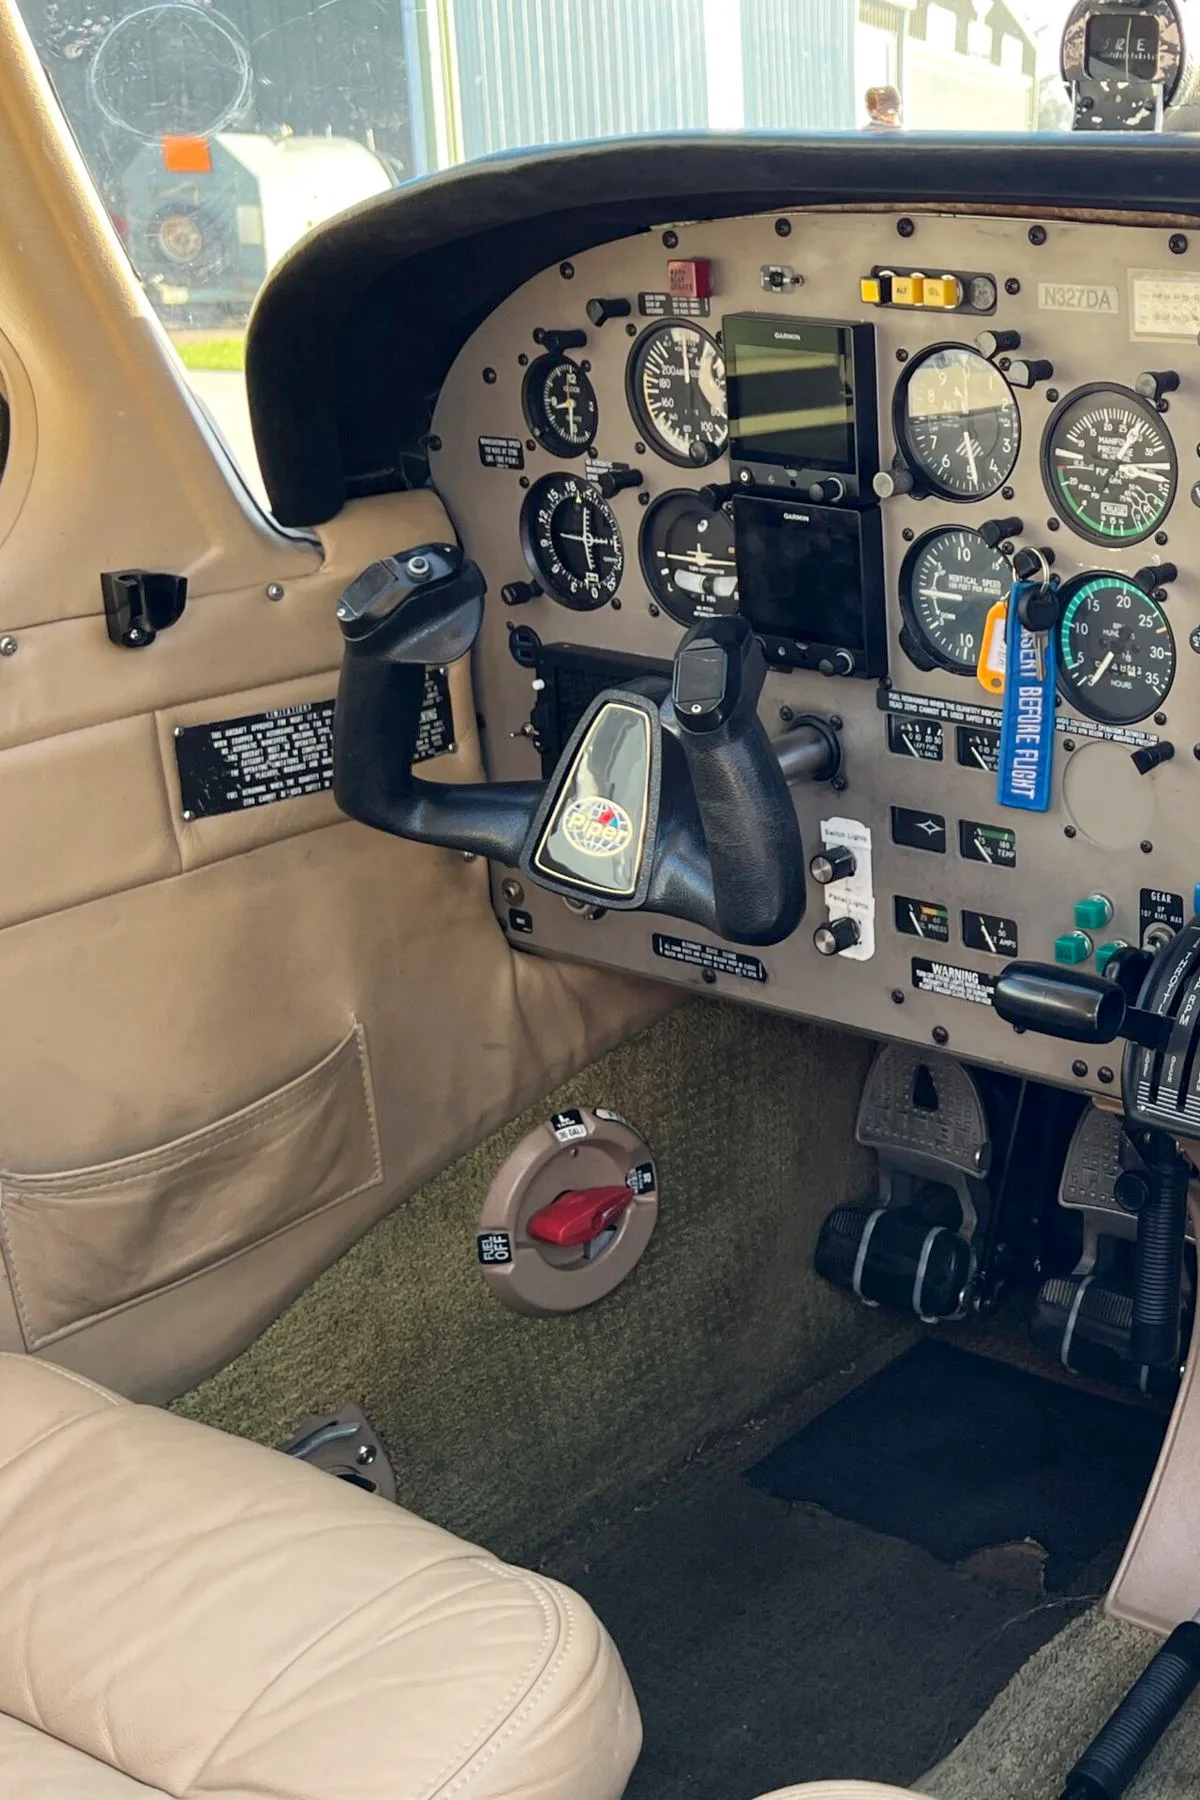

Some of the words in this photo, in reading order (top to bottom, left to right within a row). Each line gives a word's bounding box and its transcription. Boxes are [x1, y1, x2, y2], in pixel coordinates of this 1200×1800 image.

[1043, 291, 1113, 310] N327DA
[774, 332, 801, 340] GARMIN
[661, 365, 675, 375] 200
[659, 379, 671, 389] 180
[661, 397, 674, 408] 160
[942, 400, 957, 411] ALT
[700, 421, 714, 432] 100
[565, 481, 577, 491] 18
[547, 489, 559, 502] 15
[538, 509, 548, 524] 12
[783, 513, 810, 522] GARMIN
[957, 547, 971, 562] 10
[948, 574, 978, 587] VERTICAL
[981, 578, 1001, 588] SPEED
[1087, 598, 1100, 612] 15
[1116, 595, 1132, 608] 20
[1138, 614, 1153, 628] 25
[1075, 622, 1088, 635] 10
[960, 632, 974, 648] 10
[1149, 646, 1165, 659] 30
[1110, 680, 1132, 690] HOURS
[1145, 672, 1160, 685] 35
[1015, 686, 1043, 744] BEFORE
[1011, 750, 1038, 800] FLIGHT
[566, 811, 629, 844] Piper
[824, 828, 846, 839] Switch
[847, 832, 868, 842] Lights
[997, 849, 1015, 858] TEMP
[1151, 892, 1172, 903] GEAR
[1140, 909, 1151, 917] 107
[1154, 911, 1168, 920] KIAS
[1170, 915, 1182, 923] MAX
[999, 939, 1017, 949] AMPS
[931, 962, 979, 985] WARNING
[1179, 994, 1197, 1026] RPM
[481, 1236, 494, 1260] FUEL
[493, 1236, 509, 1260] OFF
